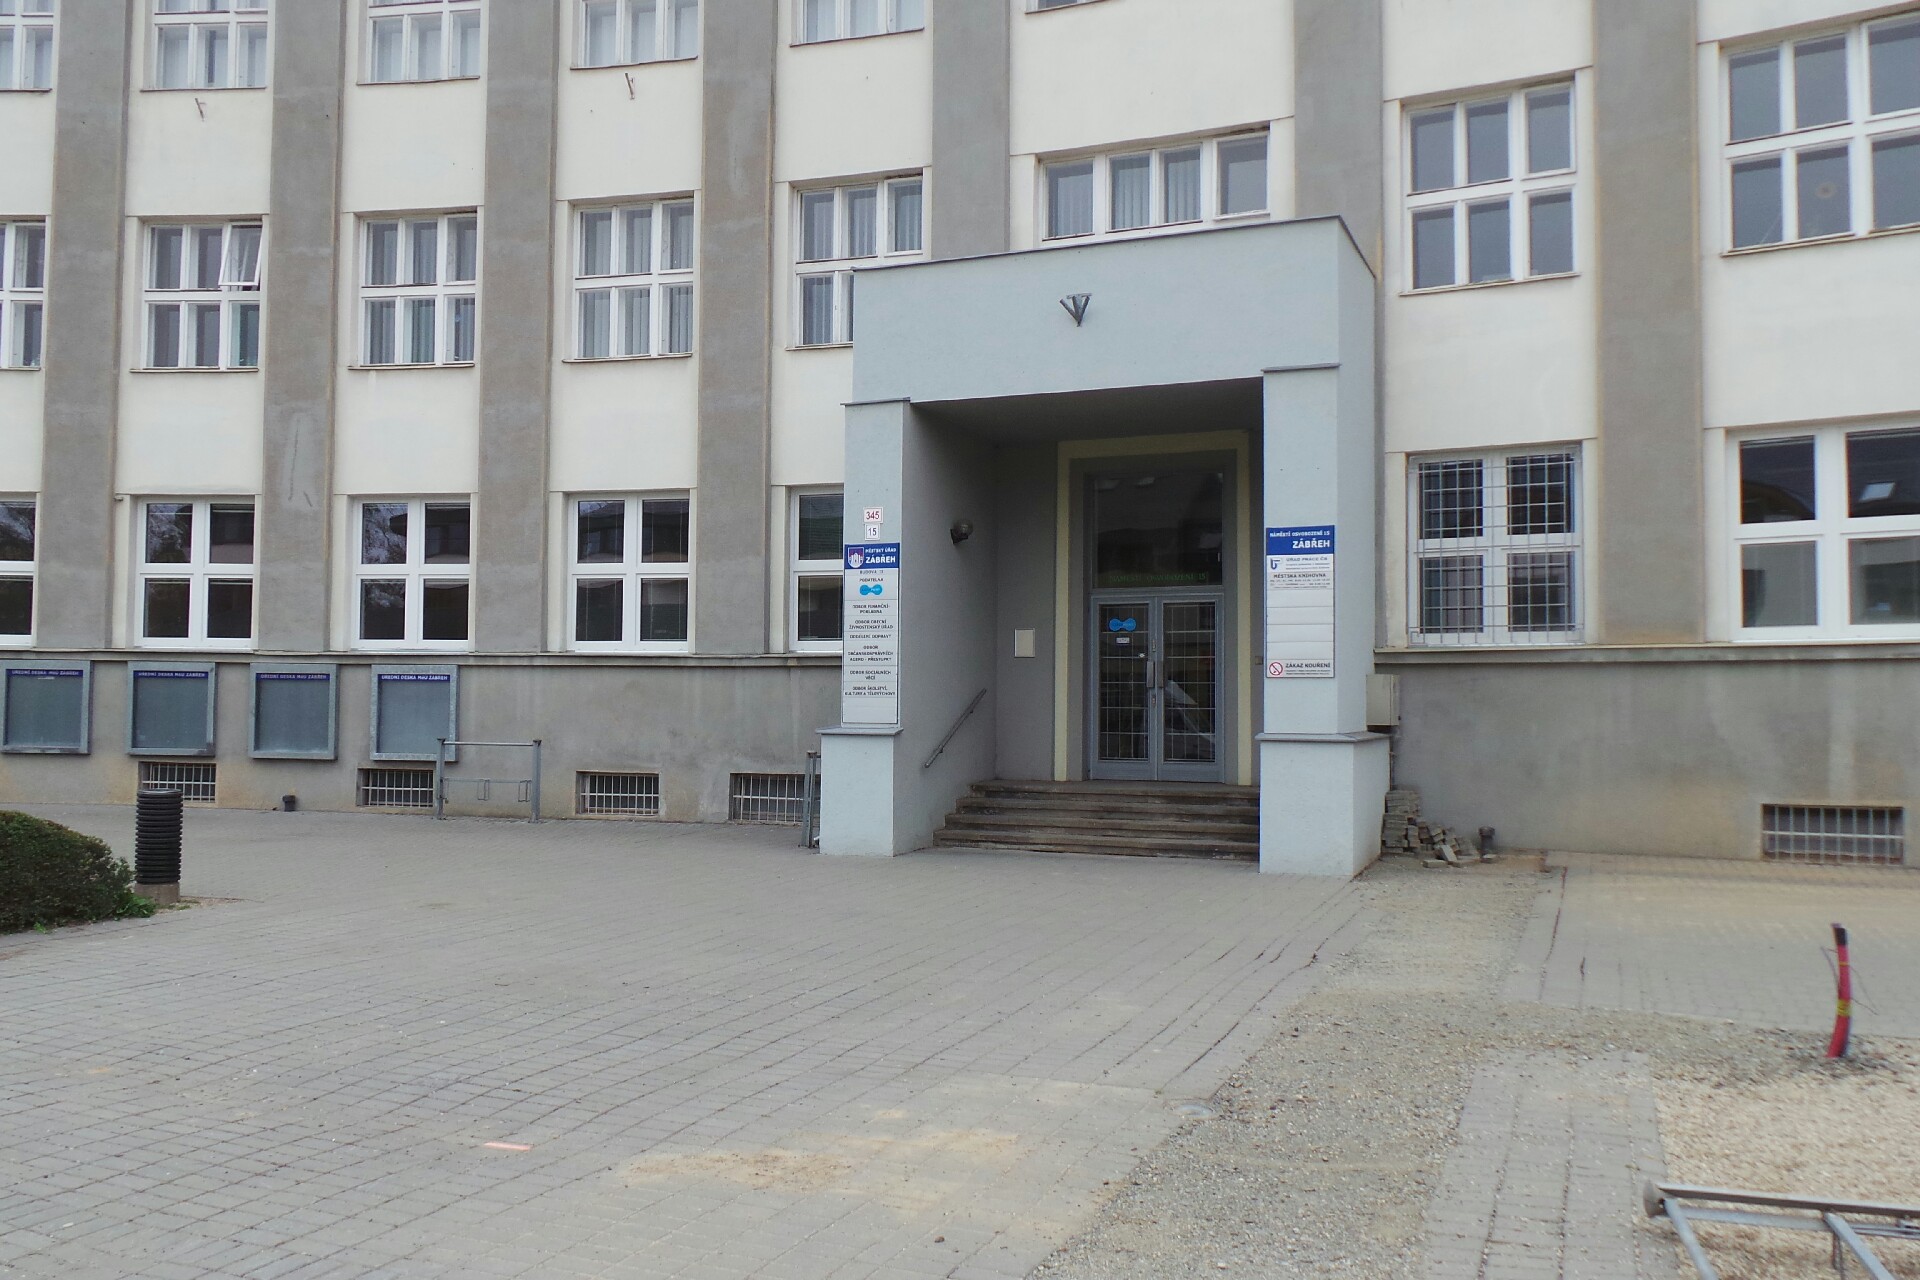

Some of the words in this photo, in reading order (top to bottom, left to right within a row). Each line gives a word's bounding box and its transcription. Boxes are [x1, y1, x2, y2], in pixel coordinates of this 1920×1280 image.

[866, 511, 880, 520] 345
[868, 528, 876, 536] 15
[1292, 538, 1330, 548] ZÁBŘEH
[866, 554, 896, 563] ZÁBŘEH
